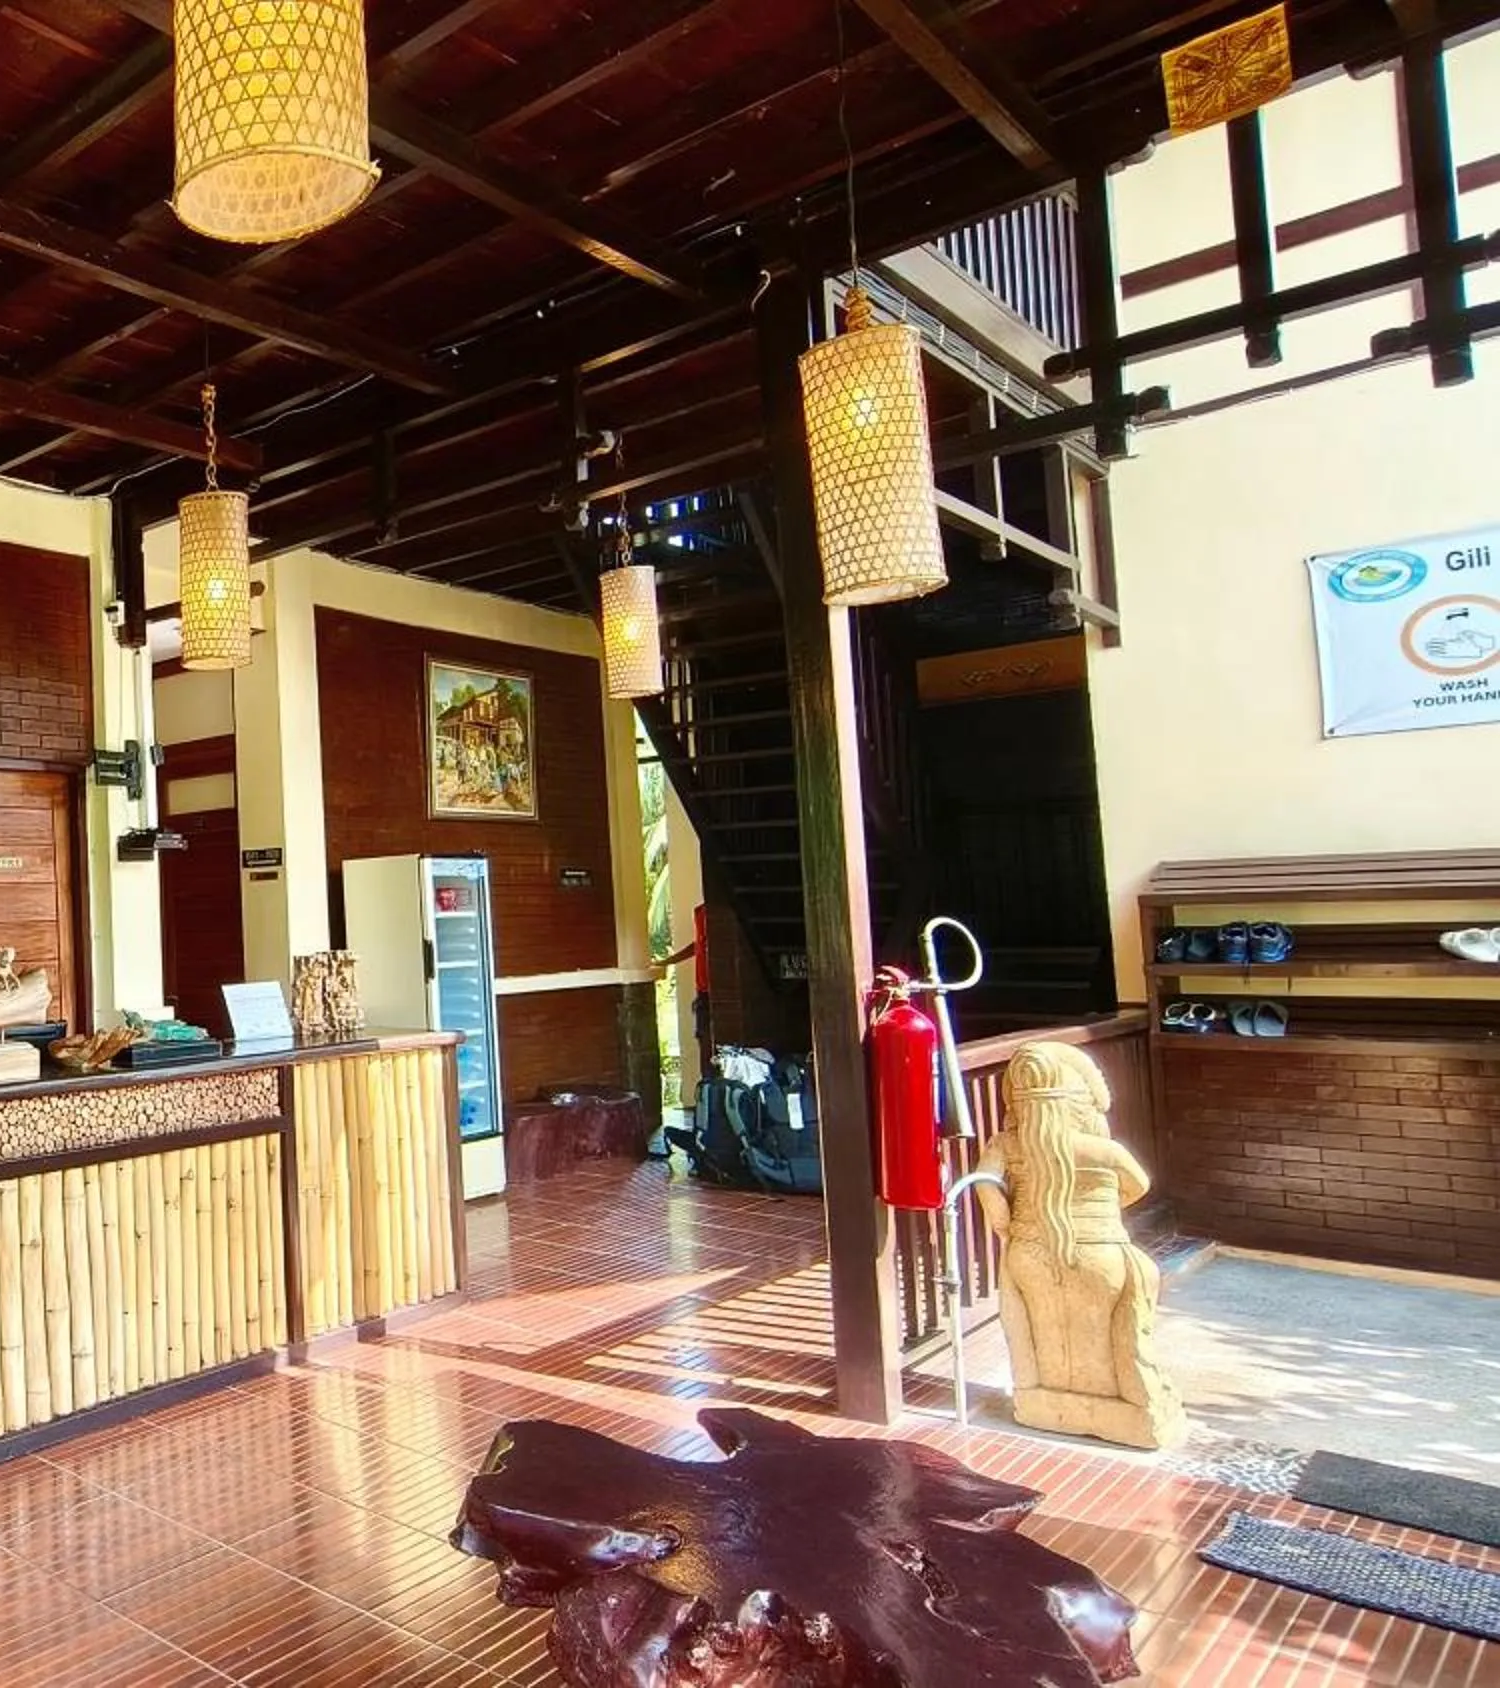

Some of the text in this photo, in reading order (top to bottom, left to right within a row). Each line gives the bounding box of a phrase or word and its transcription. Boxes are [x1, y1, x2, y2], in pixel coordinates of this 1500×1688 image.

[1445, 546, 1491, 571] Gili
[1439, 678, 1489, 691] WASH
[1412, 690, 1500, 708] YOUR HAN
